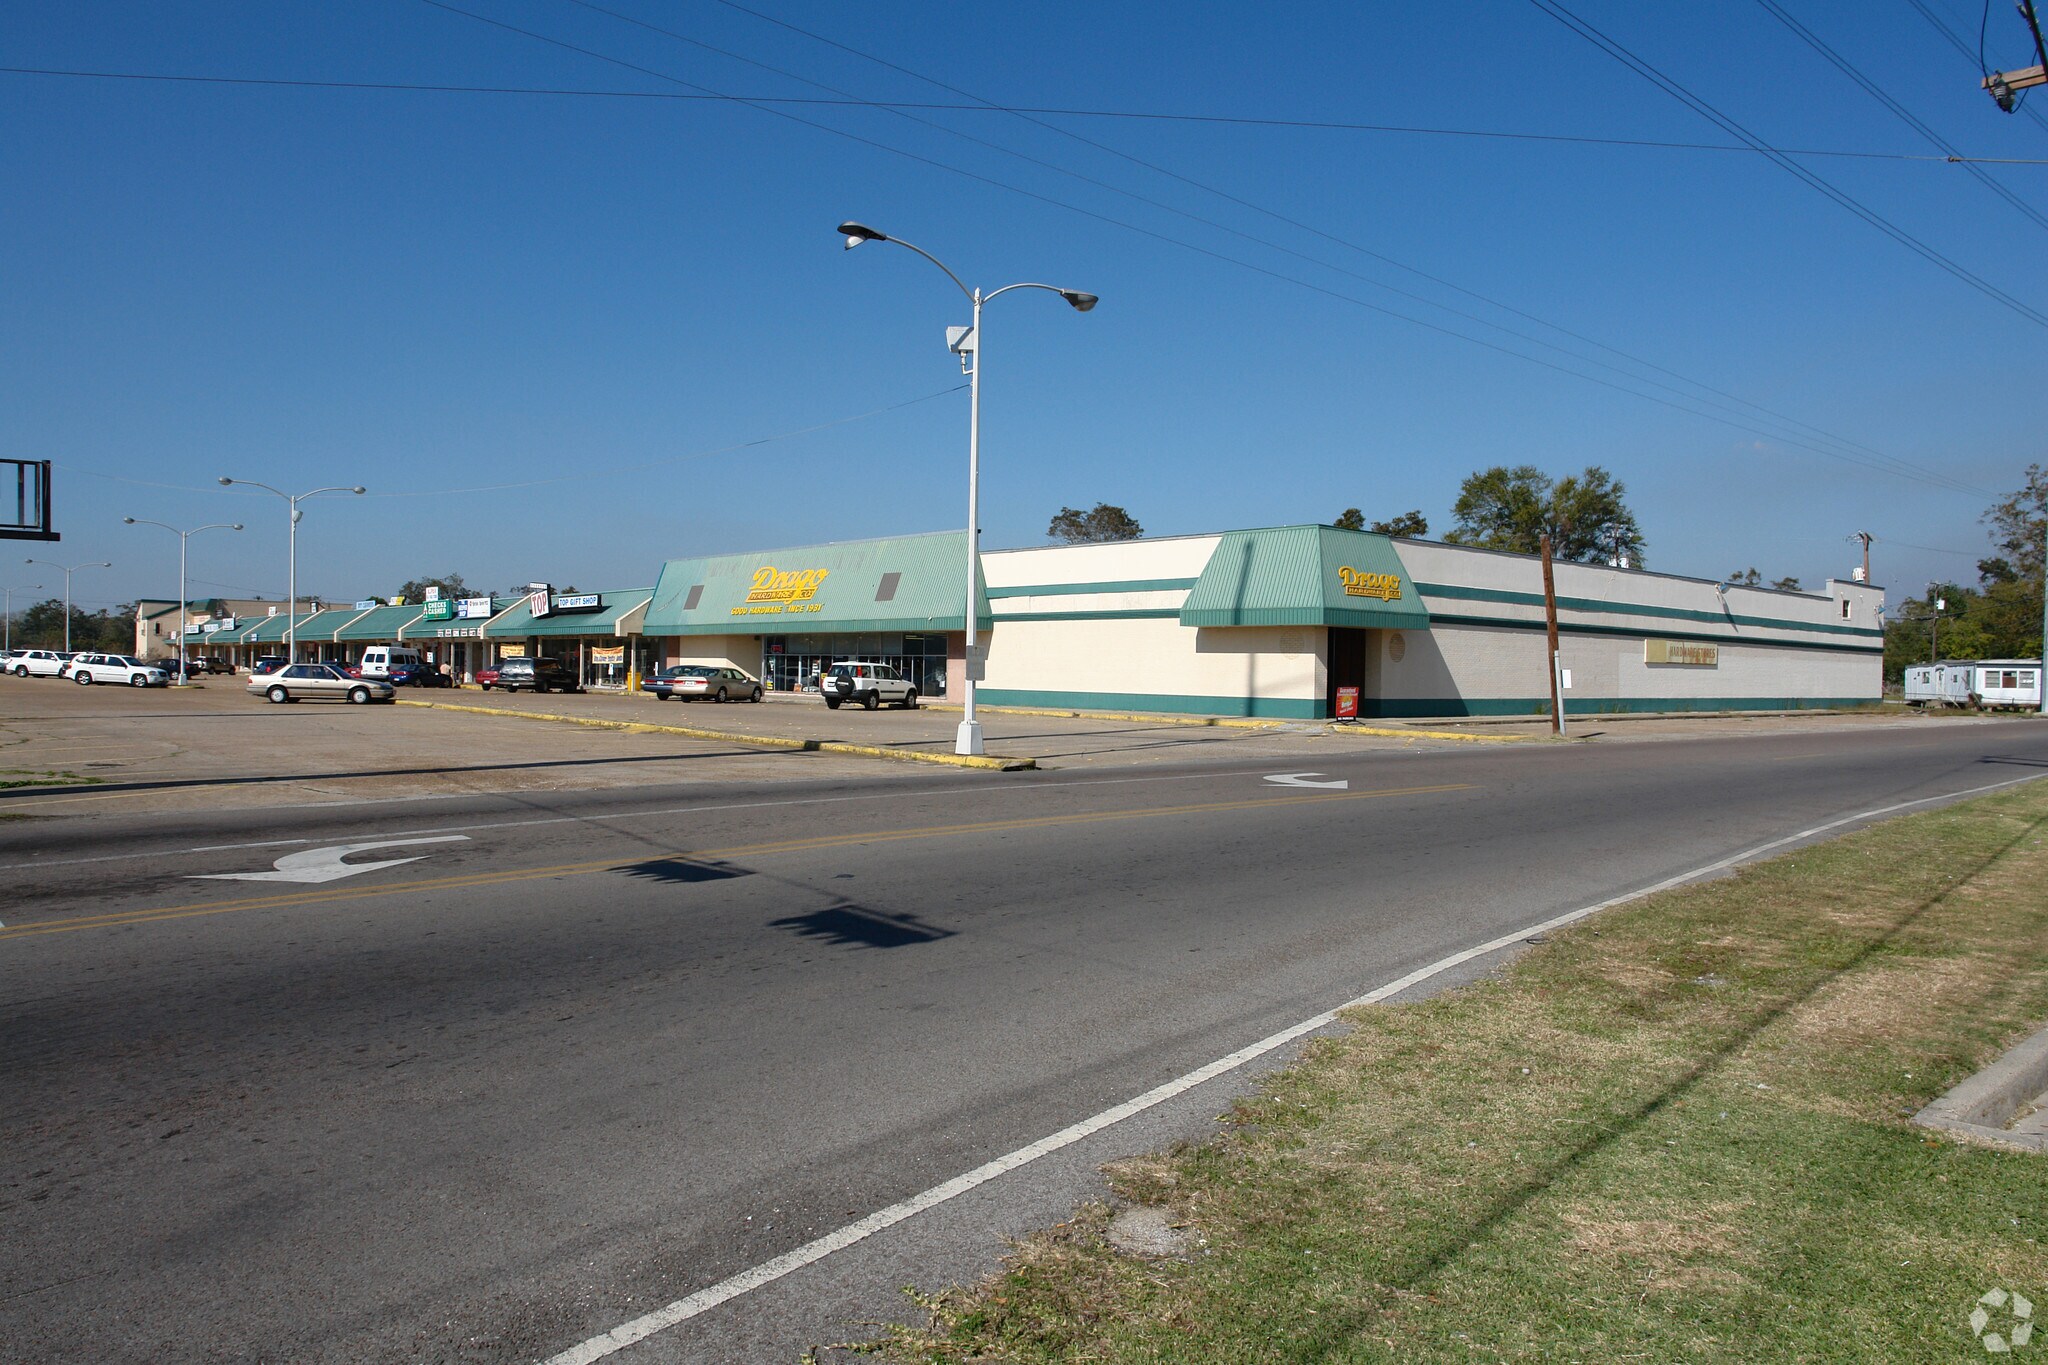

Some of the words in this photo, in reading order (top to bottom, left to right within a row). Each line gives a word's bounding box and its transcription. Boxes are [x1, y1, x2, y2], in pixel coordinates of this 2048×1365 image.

[749, 566, 830, 605] Drago
[1338, 566, 1401, 602] Drago
[751, 591, 793, 600] HARDWARE
[1348, 587, 1386, 596] HARDWARE
[532, 592, 547, 616] TOP
[570, 598, 581, 606] GIFT
[583, 597, 597, 605] SHOP
[731, 606, 749, 615] GOOD
[749, 605, 783, 614] HARDWARE
